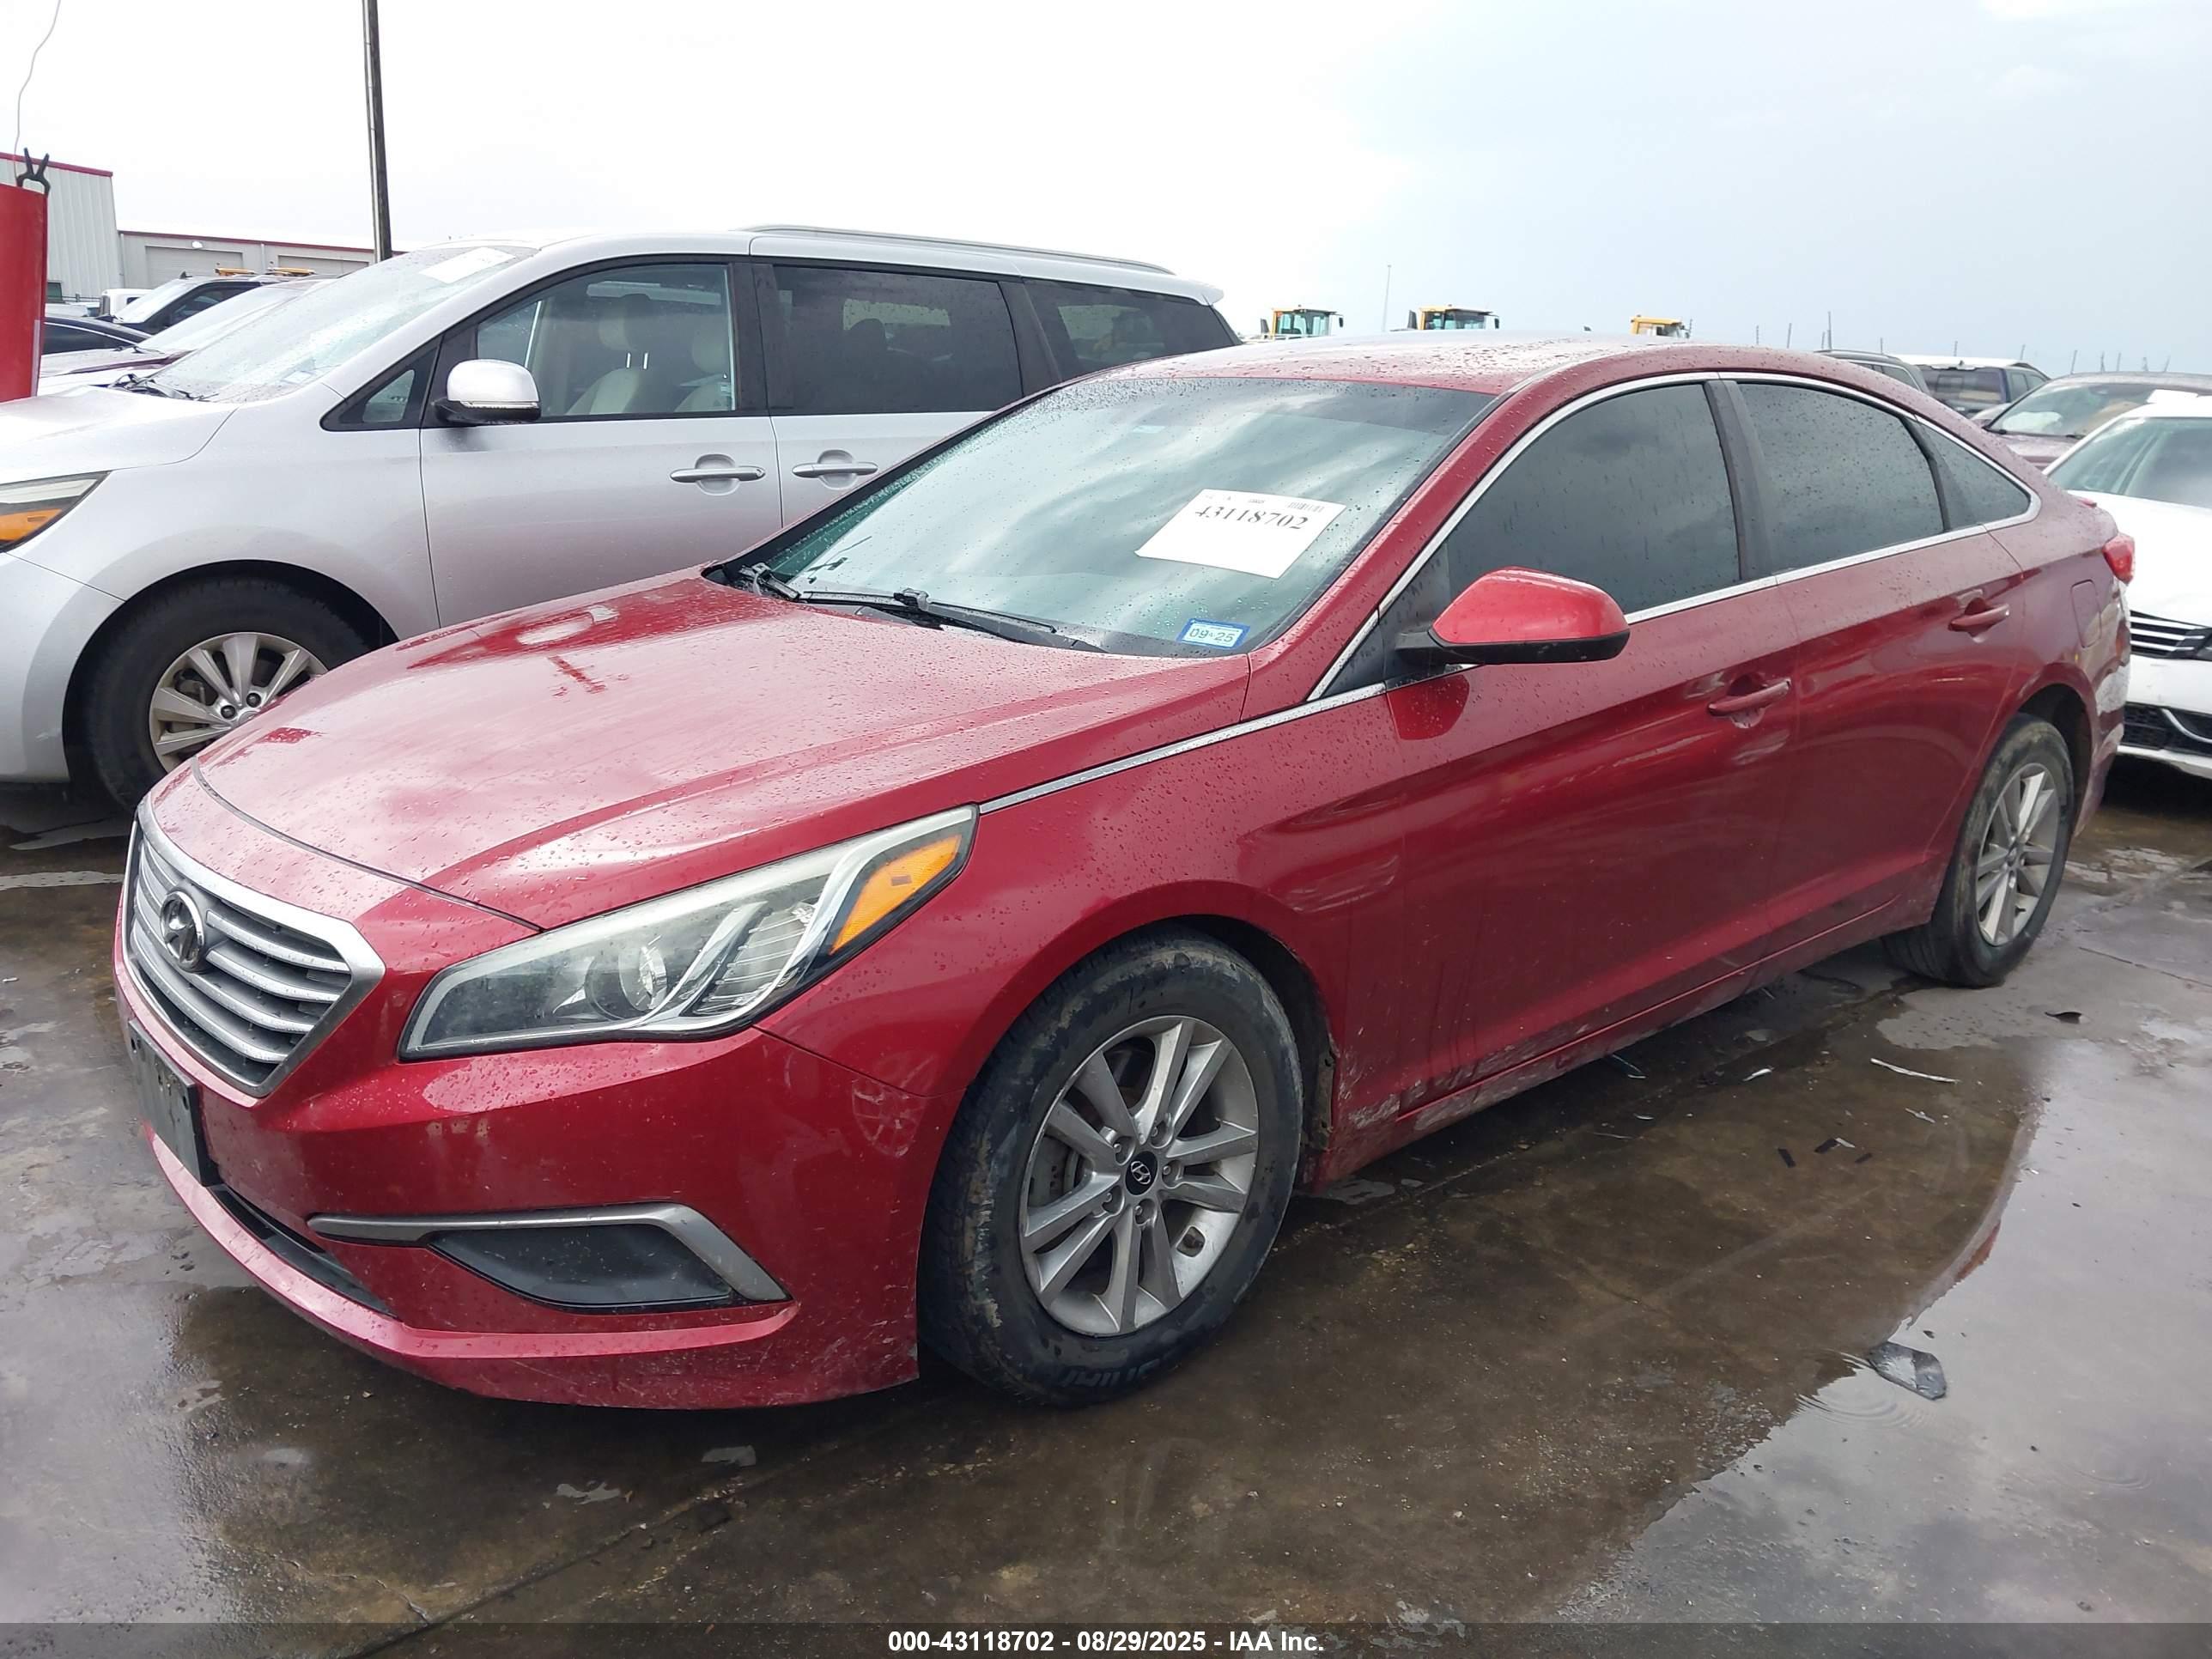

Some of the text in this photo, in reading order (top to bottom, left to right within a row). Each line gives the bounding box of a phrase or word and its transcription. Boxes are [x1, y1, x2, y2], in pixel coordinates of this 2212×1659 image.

[1194, 505, 1309, 530] 43118702
[1188, 628, 1210, 639] 09
[1213, 632, 1236, 642] 25
